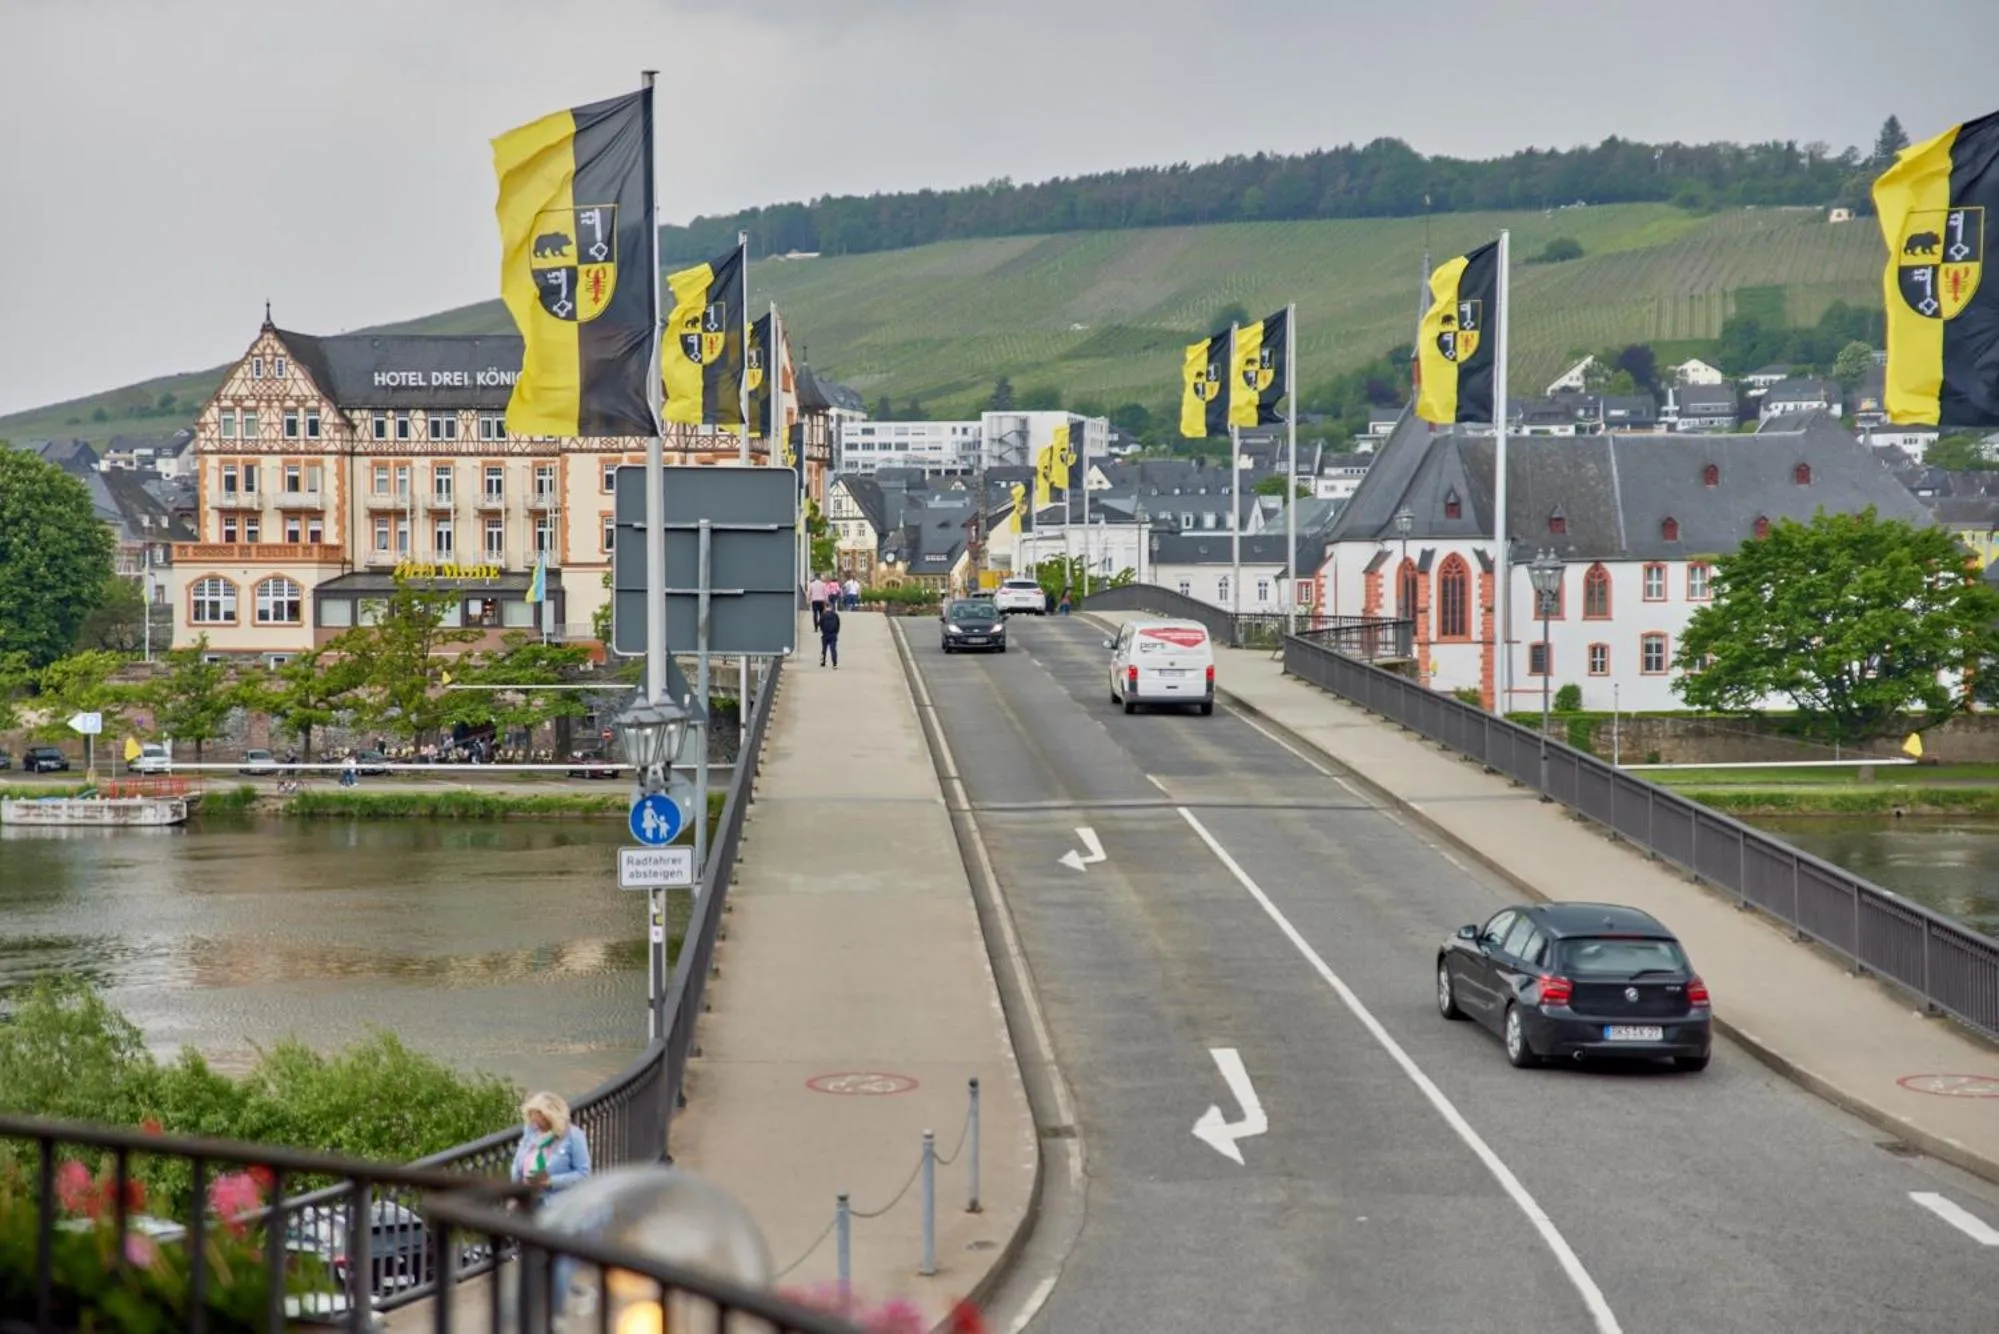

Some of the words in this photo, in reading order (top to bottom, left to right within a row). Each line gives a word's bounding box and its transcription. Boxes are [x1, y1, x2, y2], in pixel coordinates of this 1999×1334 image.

[373, 371, 427, 386] HOTEL
[431, 371, 469, 386] DREI
[626, 855, 683, 866] Radfahrer
[628, 867, 684, 880] absteigen
